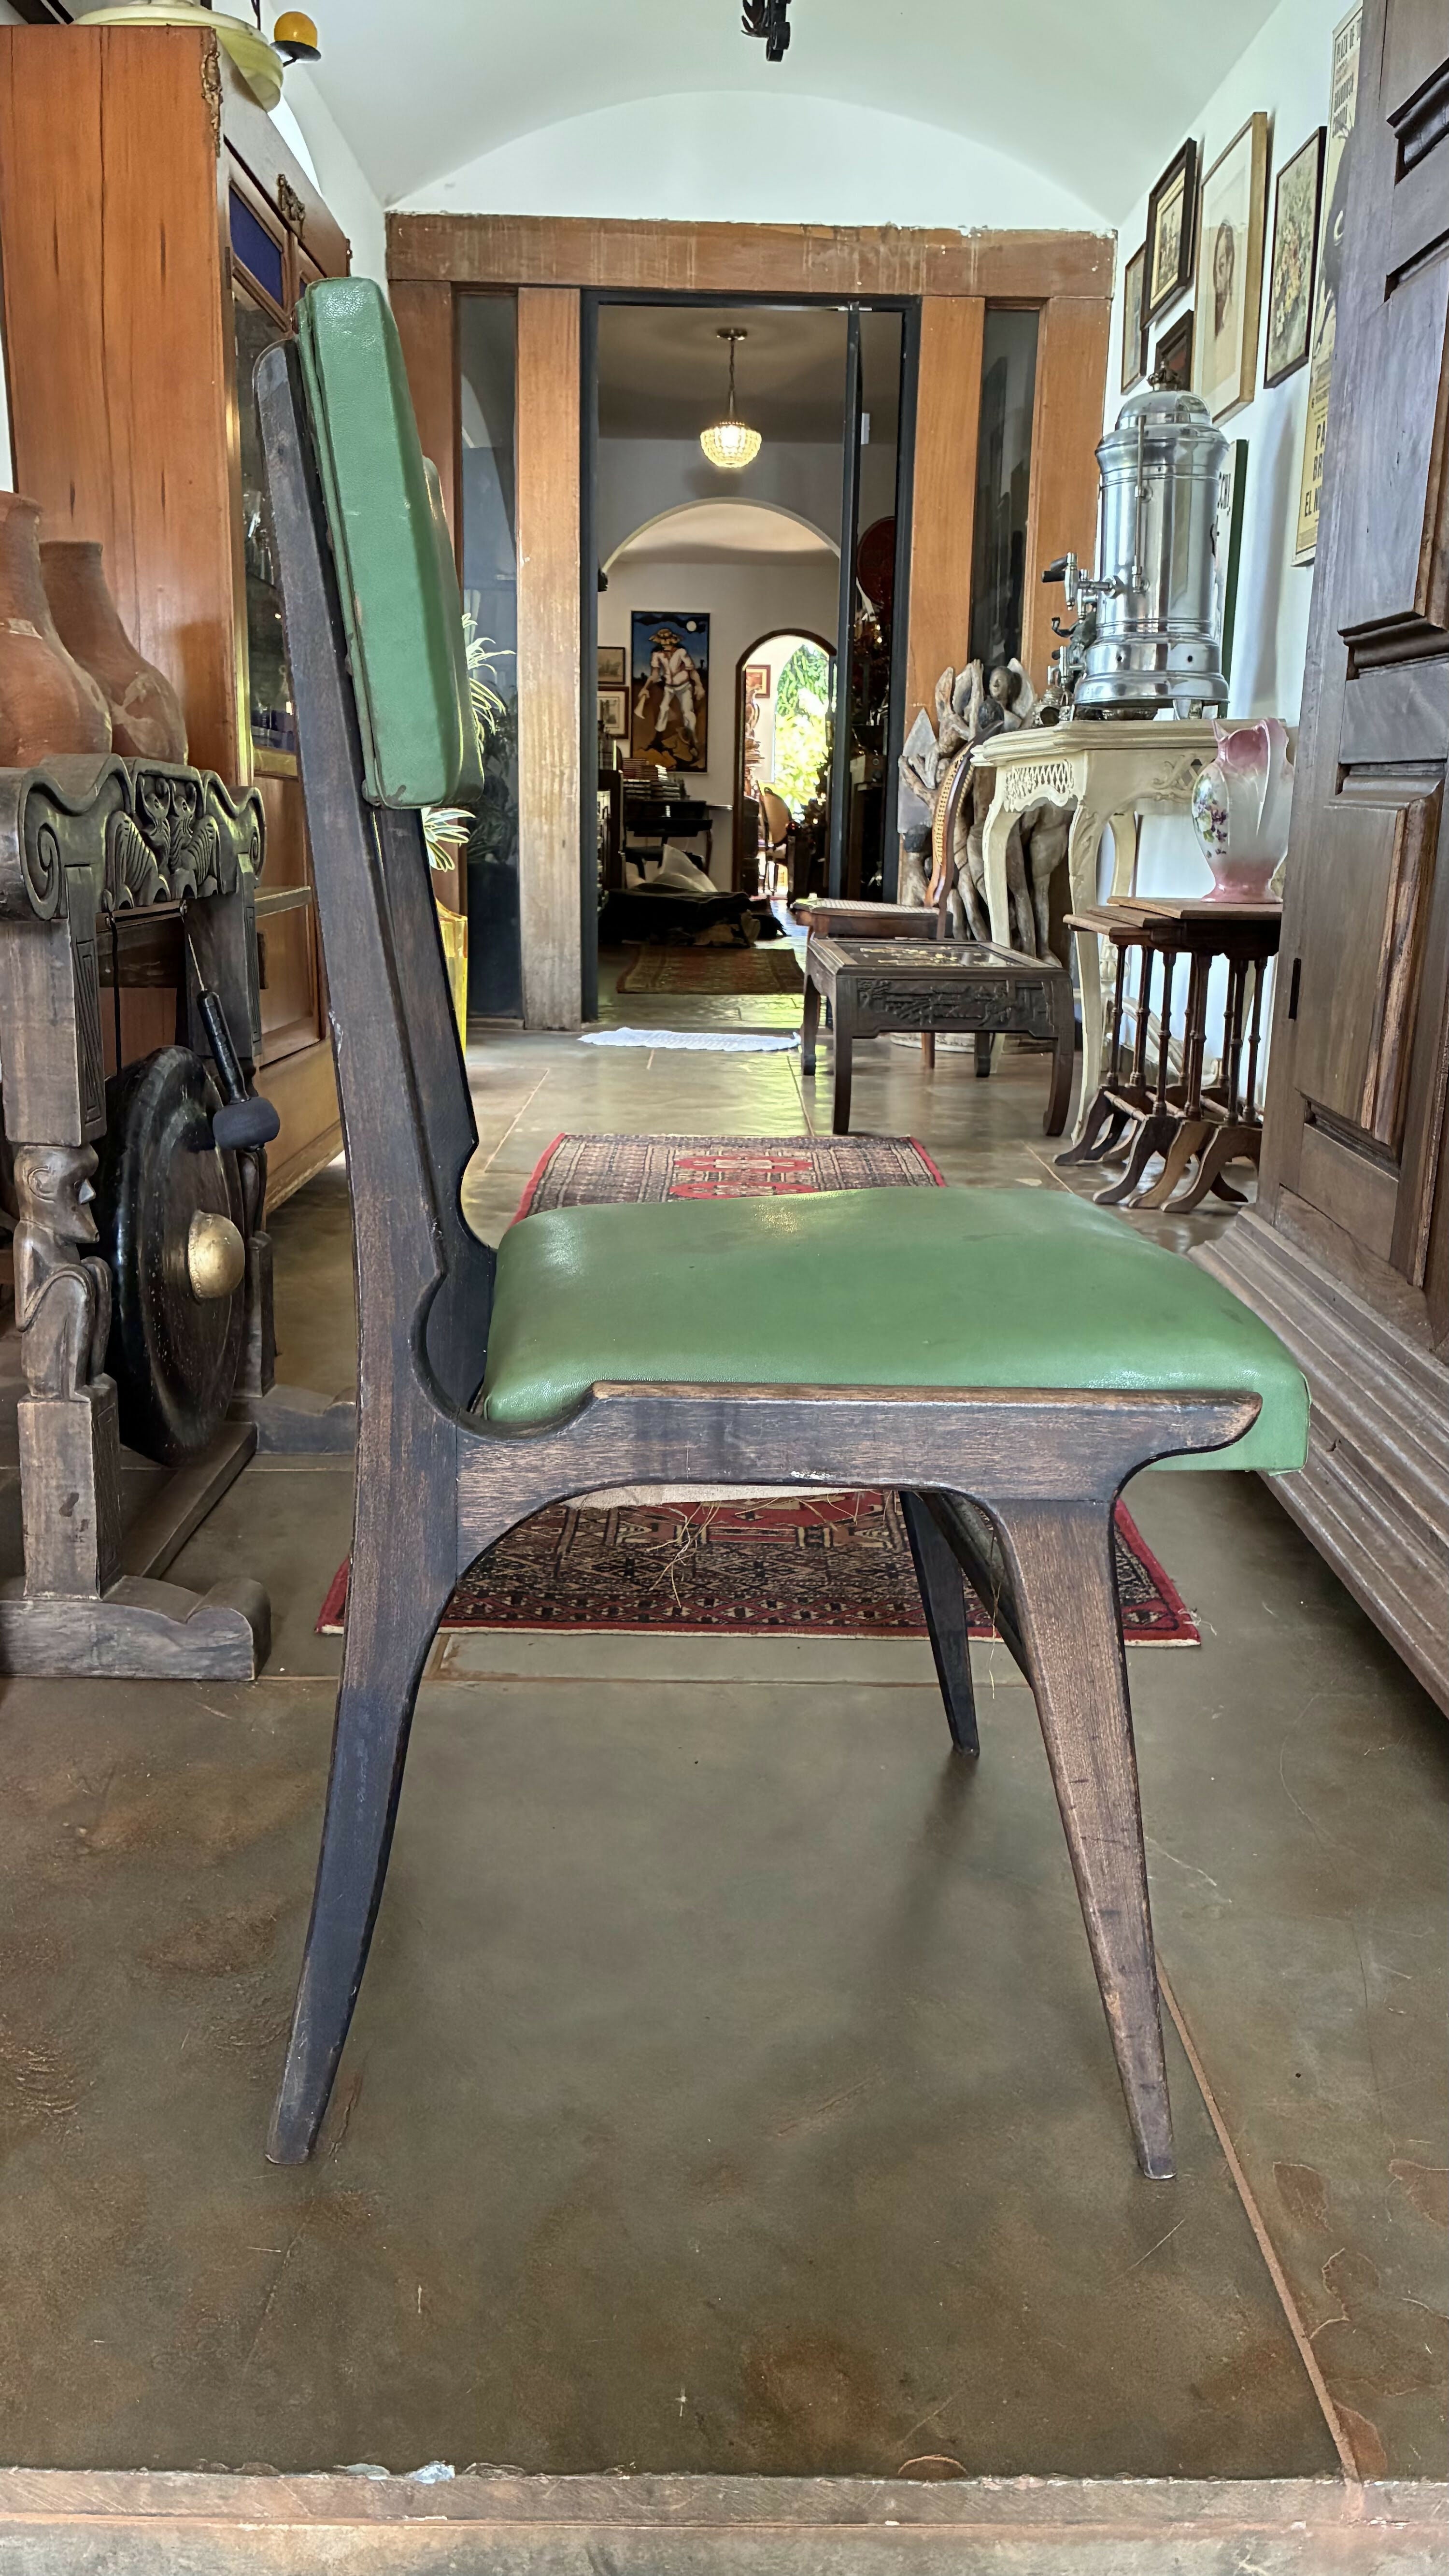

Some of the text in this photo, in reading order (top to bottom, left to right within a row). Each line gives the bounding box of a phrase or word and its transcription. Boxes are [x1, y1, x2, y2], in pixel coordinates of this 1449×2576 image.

[1315, 421, 1325, 451] PA
[1313, 453, 1322, 482] BR
[1305, 490, 1312, 517] EL
